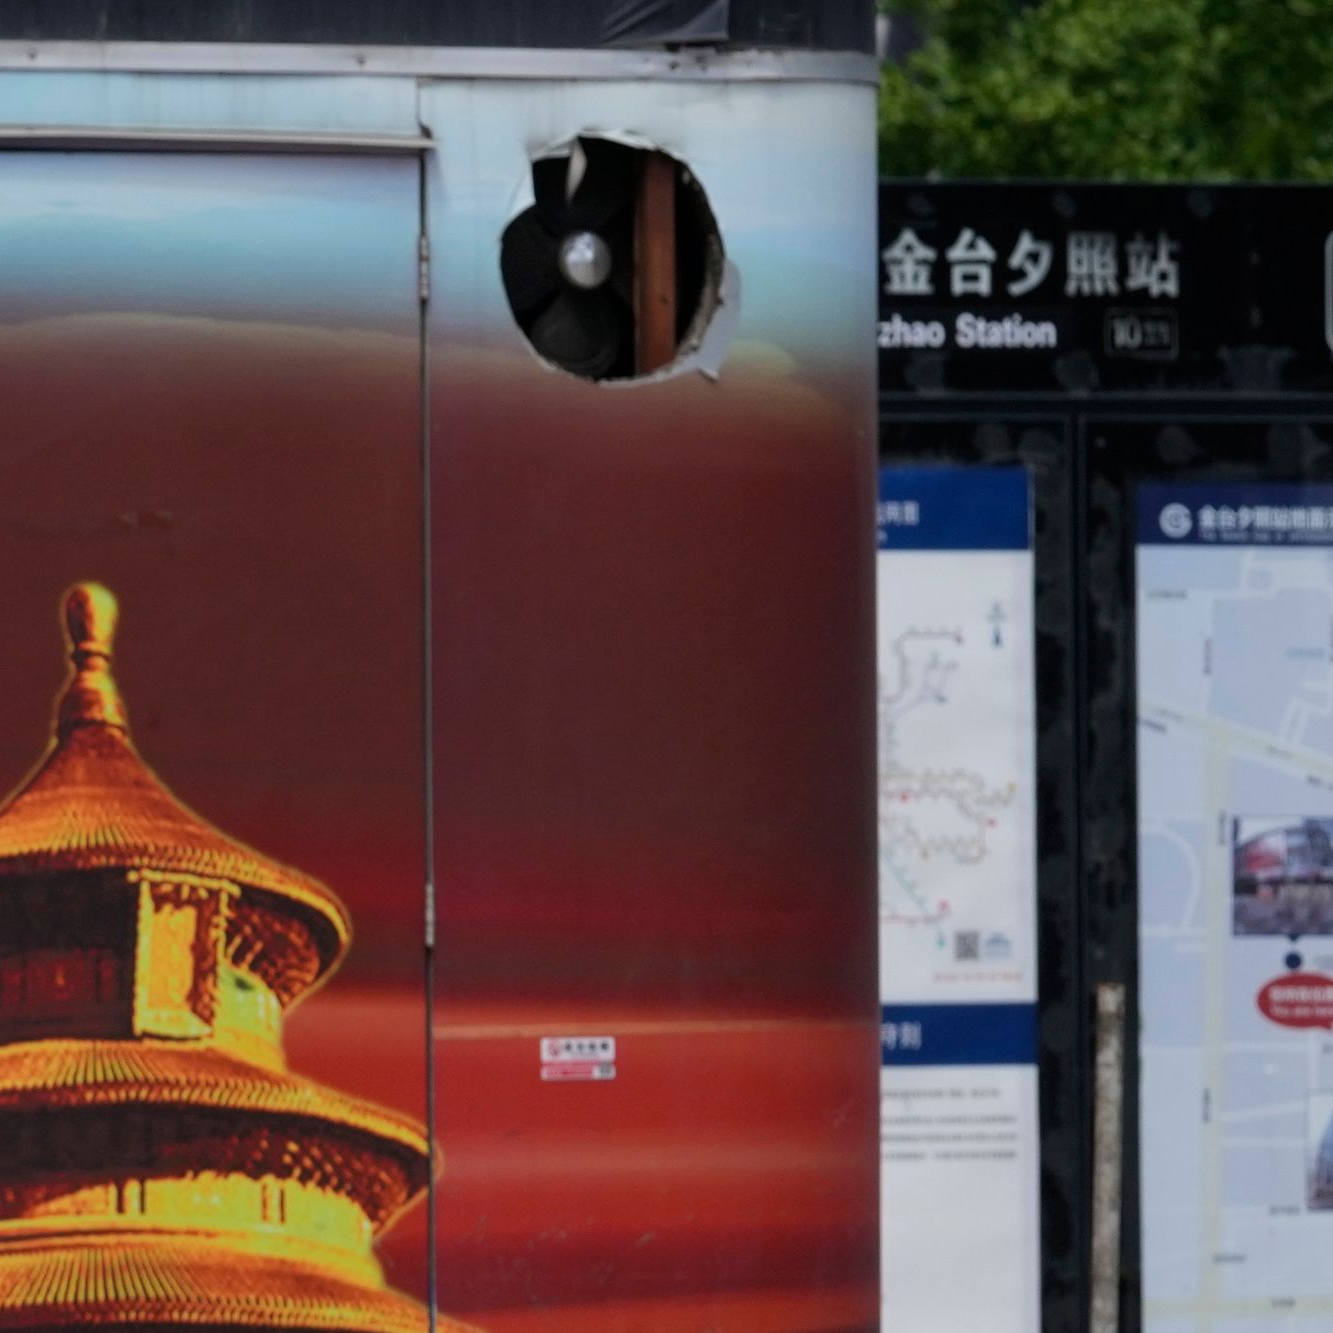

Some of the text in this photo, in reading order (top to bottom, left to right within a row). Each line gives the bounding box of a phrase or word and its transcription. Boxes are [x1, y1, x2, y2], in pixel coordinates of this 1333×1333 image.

[882, 227, 1180, 298] 金台夕照站
[955, 312, 1057, 348] Station
